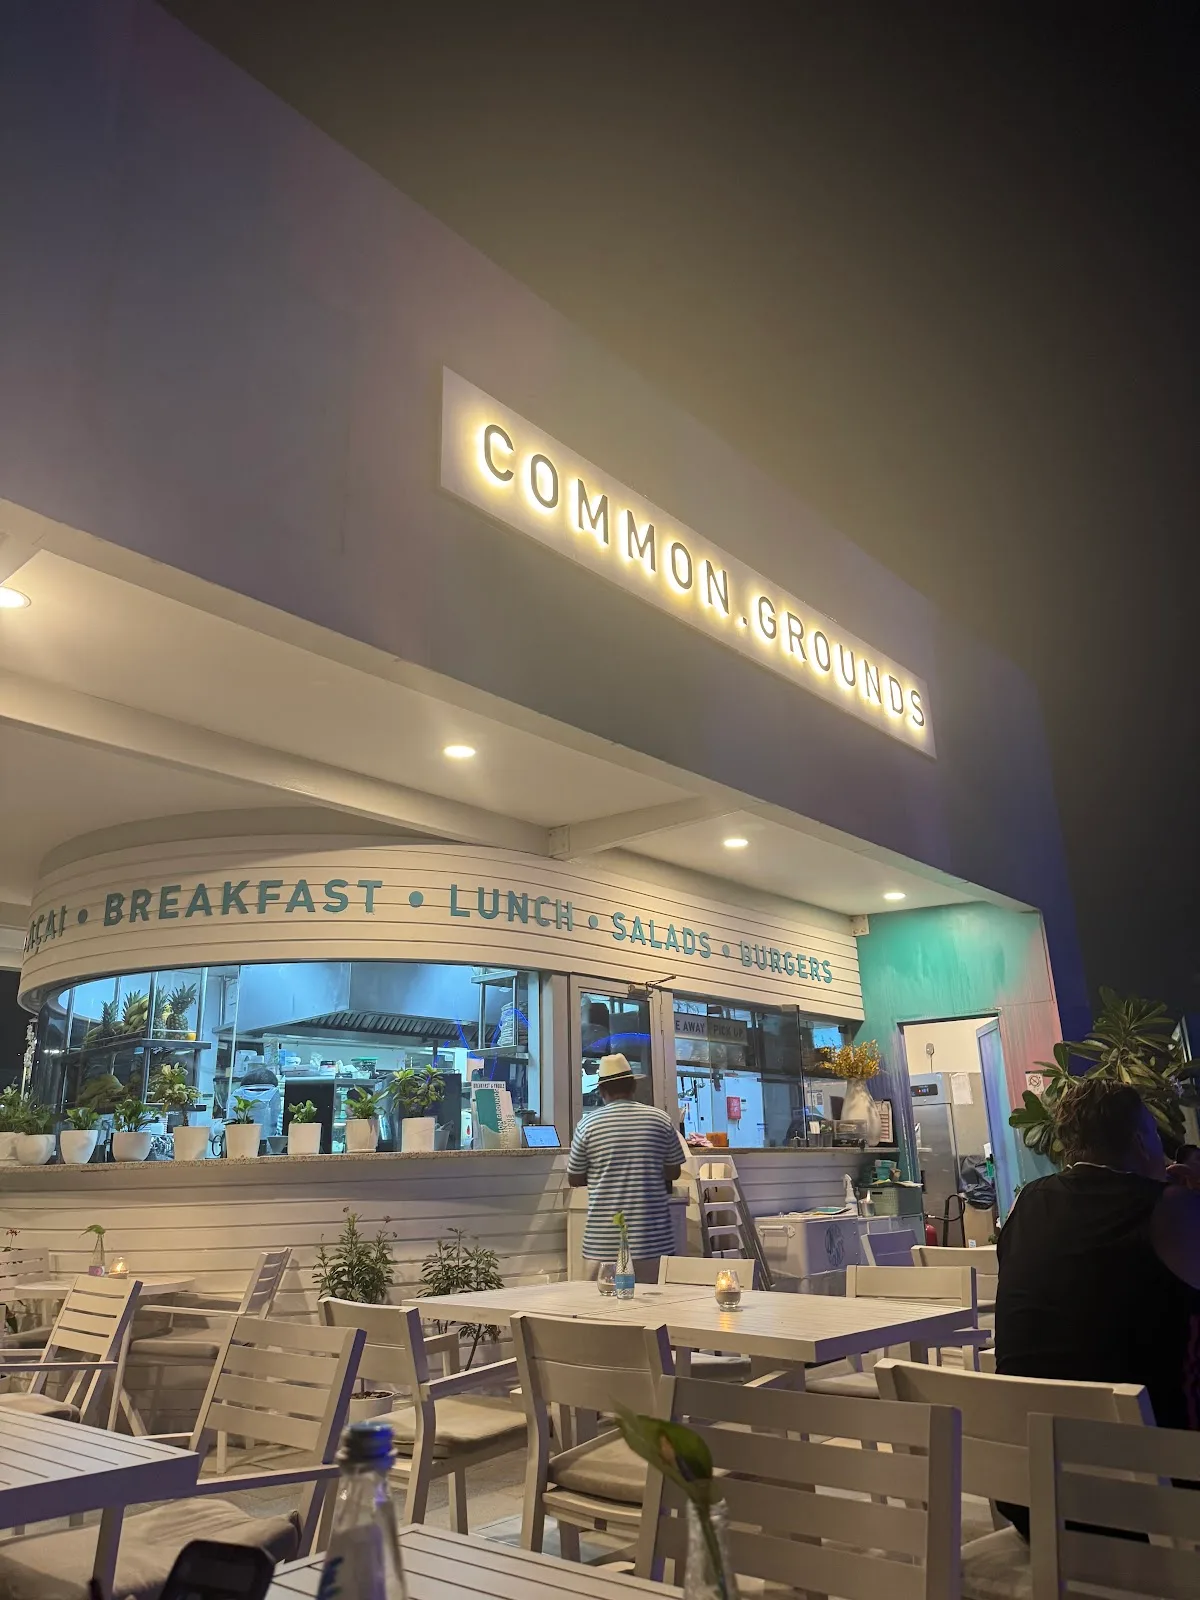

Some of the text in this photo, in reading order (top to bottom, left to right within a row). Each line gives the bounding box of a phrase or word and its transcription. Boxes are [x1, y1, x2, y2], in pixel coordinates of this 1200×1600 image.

[104, 879, 382, 926] BREAKFAST
[450, 884, 574, 930] LUNCH
[612, 911, 712, 958] SALADS
[740, 940, 833, 984] BURGERS
[683, 1021, 705, 1033] AWAY
[713, 1025, 731, 1037] PICK
[733, 1027, 744, 1038] UP
